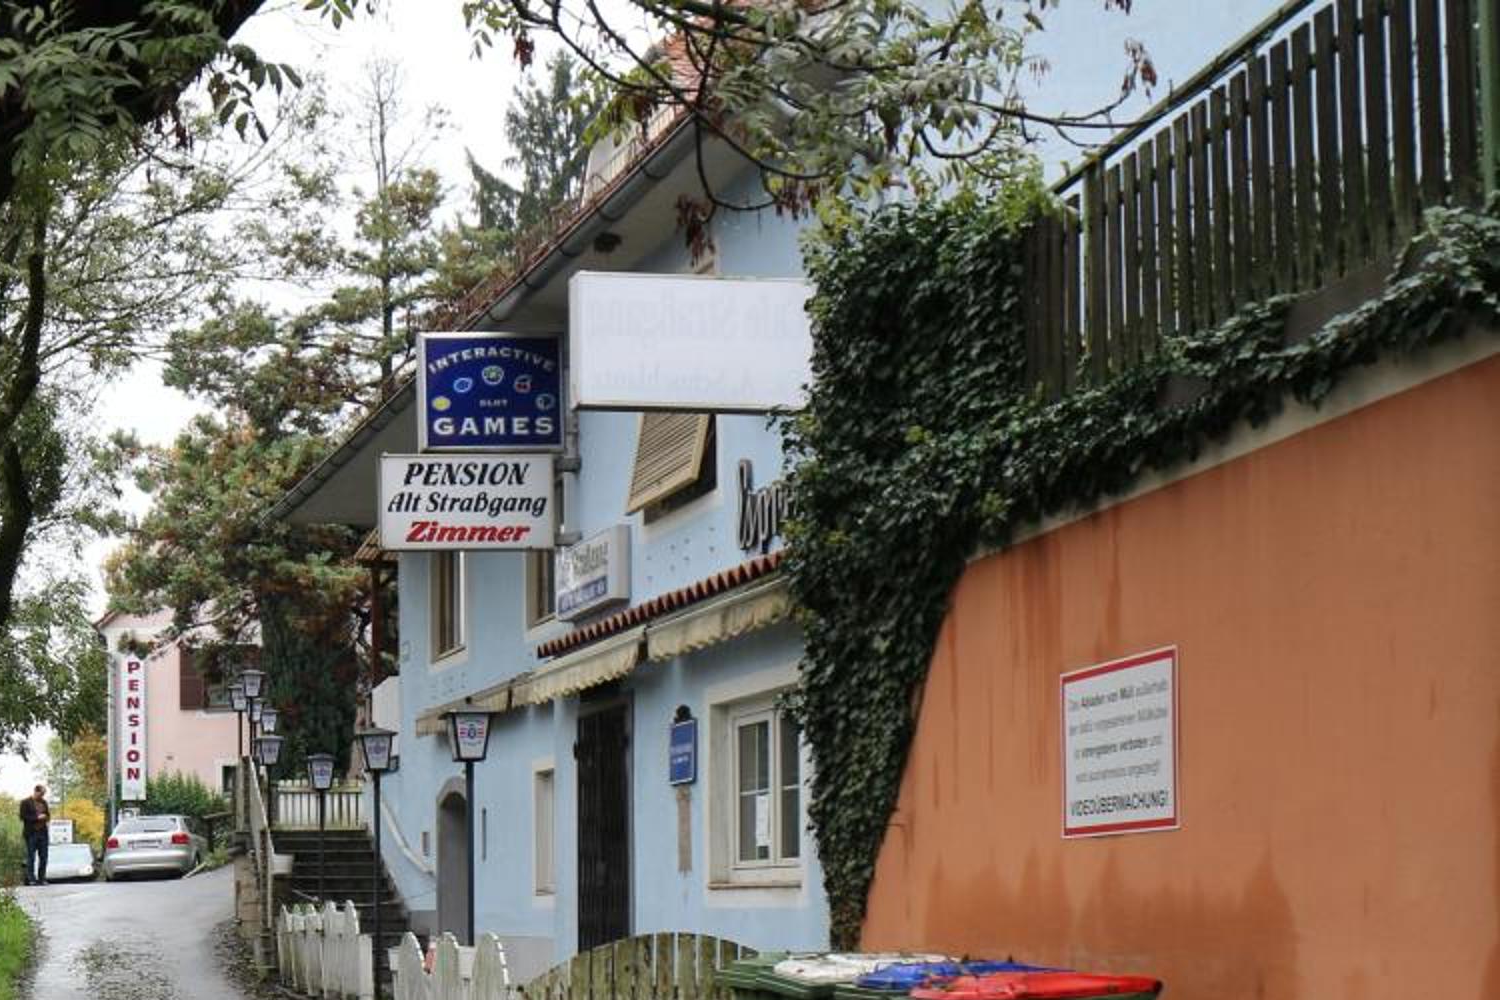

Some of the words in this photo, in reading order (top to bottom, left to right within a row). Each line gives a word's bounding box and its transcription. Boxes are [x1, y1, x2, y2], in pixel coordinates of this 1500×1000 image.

[428, 347, 556, 374] INTERACTIVE
[433, 417, 553, 435] GAMES
[404, 462, 529, 486] PENSION
[387, 491, 422, 513] Alt
[425, 491, 548, 518] Straßgang
[406, 521, 530, 542] Zimmer
[127, 662, 140, 780] PENSION
